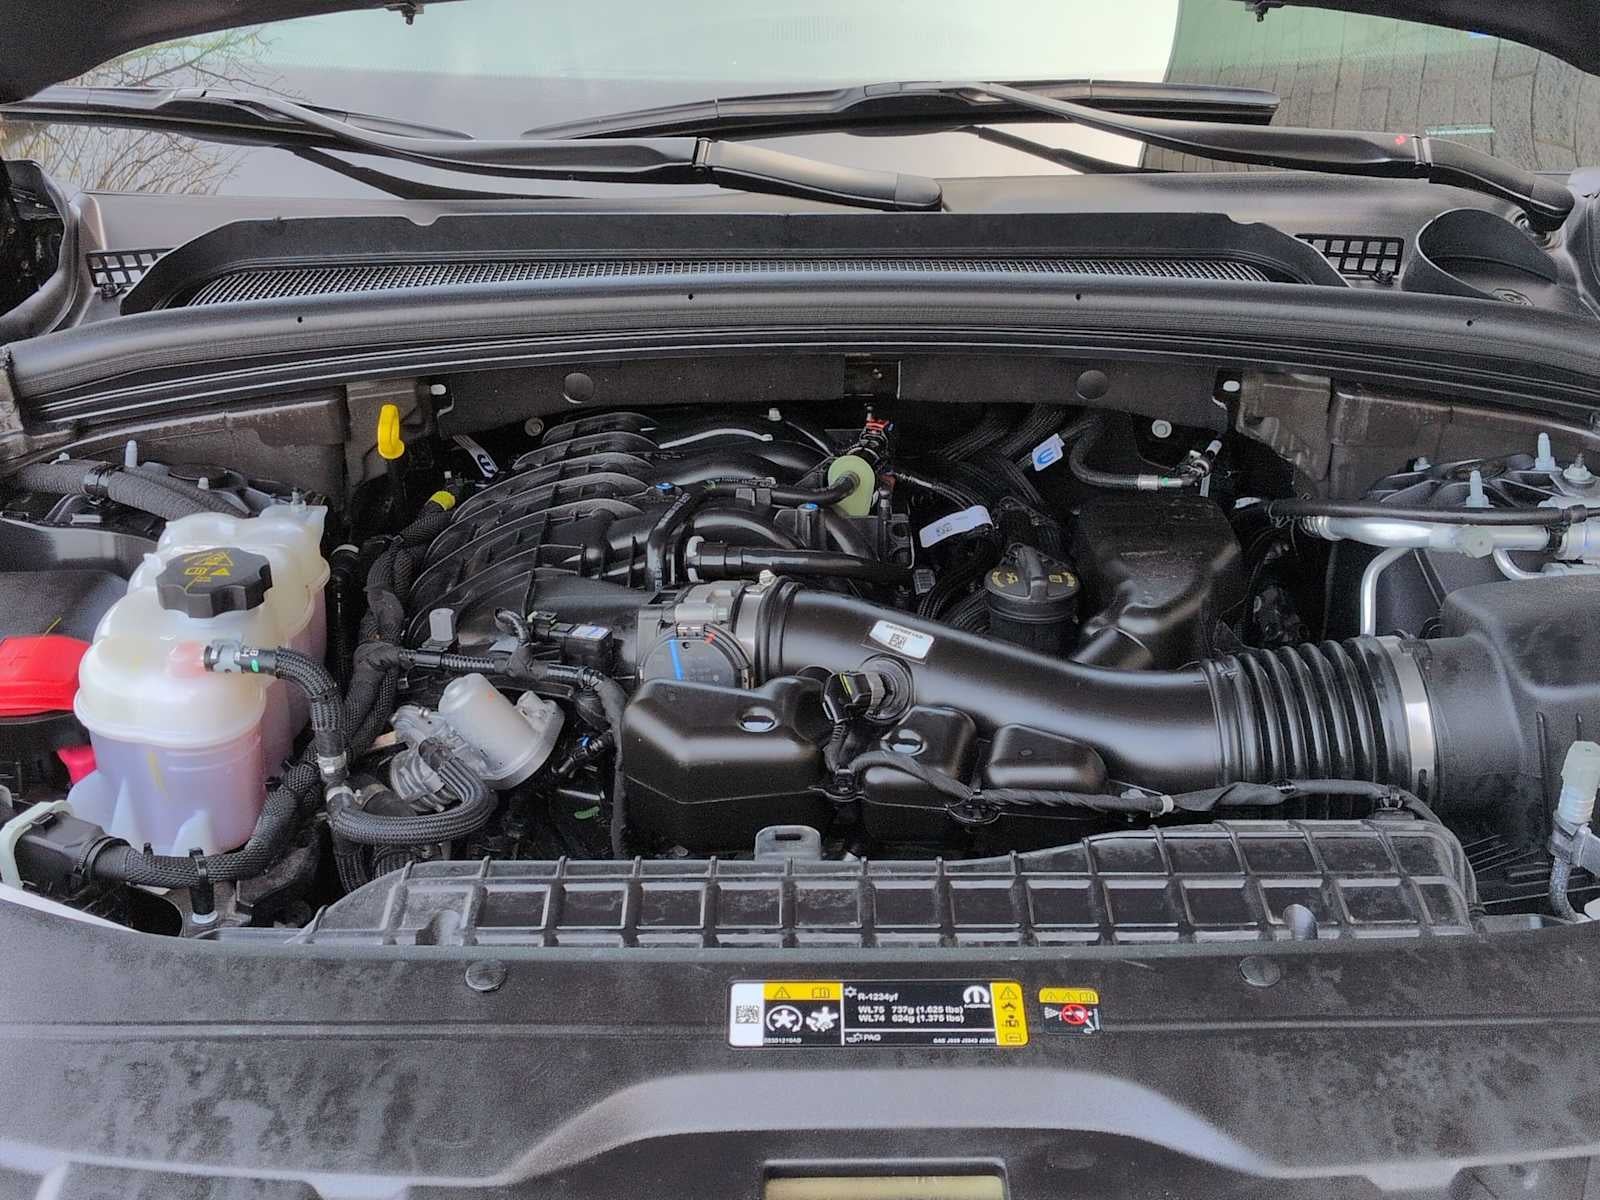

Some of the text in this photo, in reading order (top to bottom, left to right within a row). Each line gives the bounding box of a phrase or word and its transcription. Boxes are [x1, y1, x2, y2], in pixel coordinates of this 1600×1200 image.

[858, 993, 898, 1002] R-1234yf
[858, 1006, 885, 1014] WL75
[891, 1006, 915, 1015] 737g
[916, 1005, 945, 1015] (1.625
[945, 1005, 964, 1014] lbs)
[858, 1014, 885, 1023] WL74
[891, 1014, 915, 1024] 624g
[946, 1014, 965, 1024] lbs)
